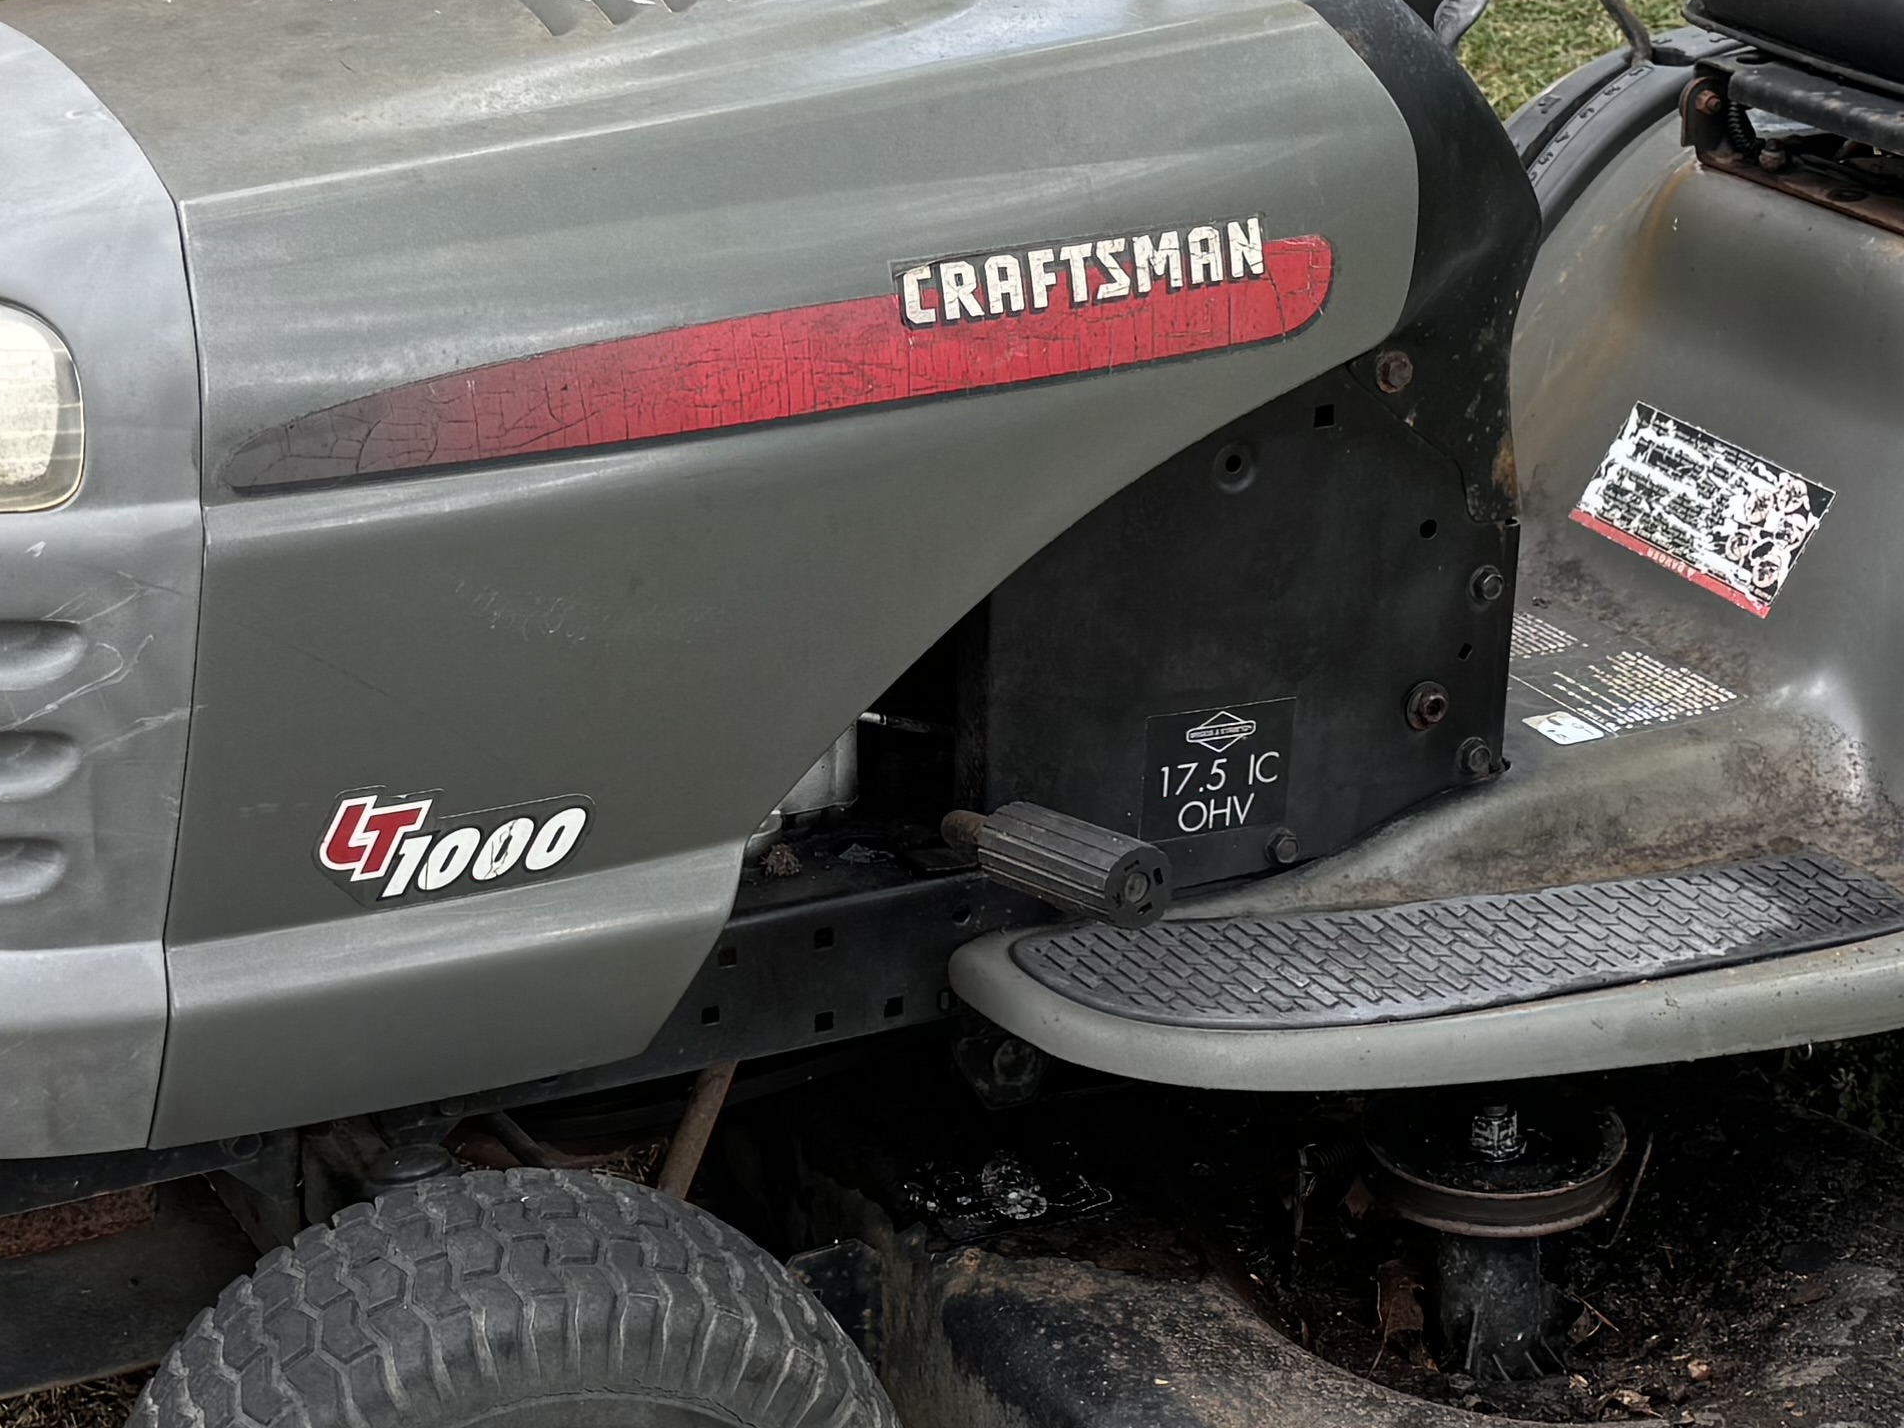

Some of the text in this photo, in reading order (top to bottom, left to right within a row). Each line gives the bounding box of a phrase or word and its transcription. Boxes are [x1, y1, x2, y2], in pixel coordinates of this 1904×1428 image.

[901, 217, 1265, 327] CRAFTSMAN
[1161, 751, 1280, 798] 17.5 IC
[1178, 792, 1255, 832] OHV
[319, 795, 587, 898] LT 1000
